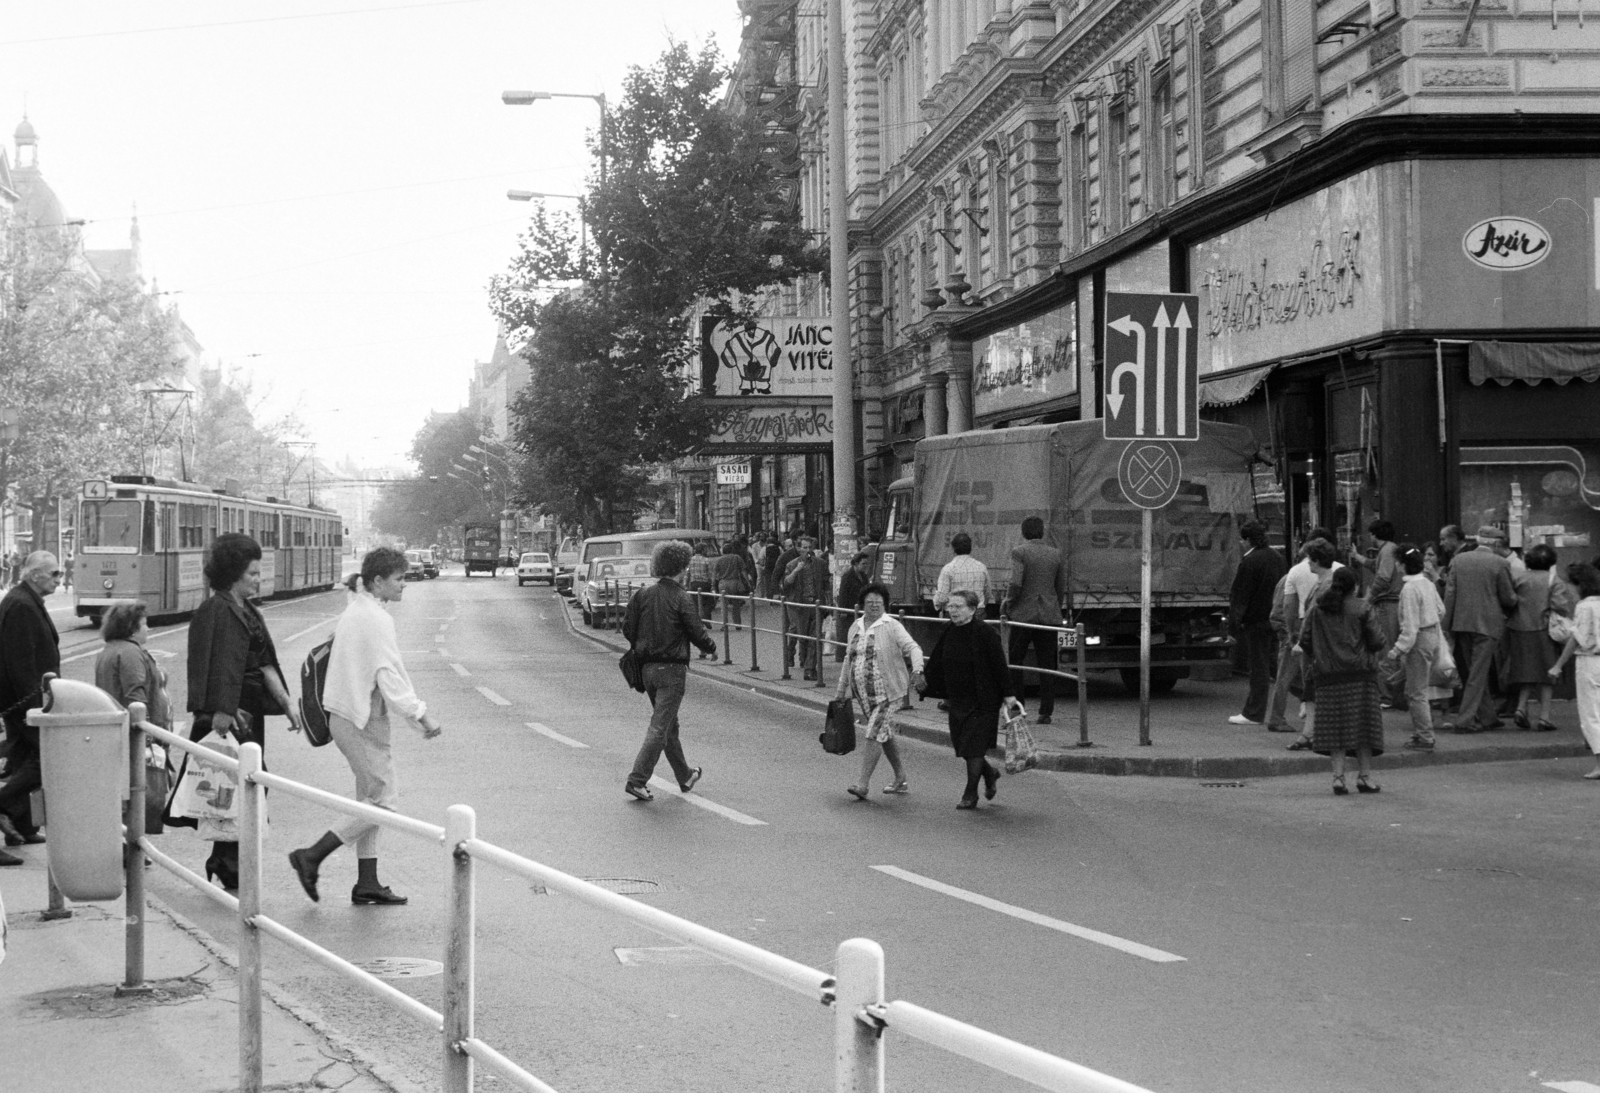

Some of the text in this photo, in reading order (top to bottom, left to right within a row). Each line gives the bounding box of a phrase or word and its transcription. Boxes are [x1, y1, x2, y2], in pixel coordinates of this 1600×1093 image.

[1470, 222, 1547, 258] Azúr
[784, 322, 833, 346] JÁNO
[90, 484, 98, 497] 4
